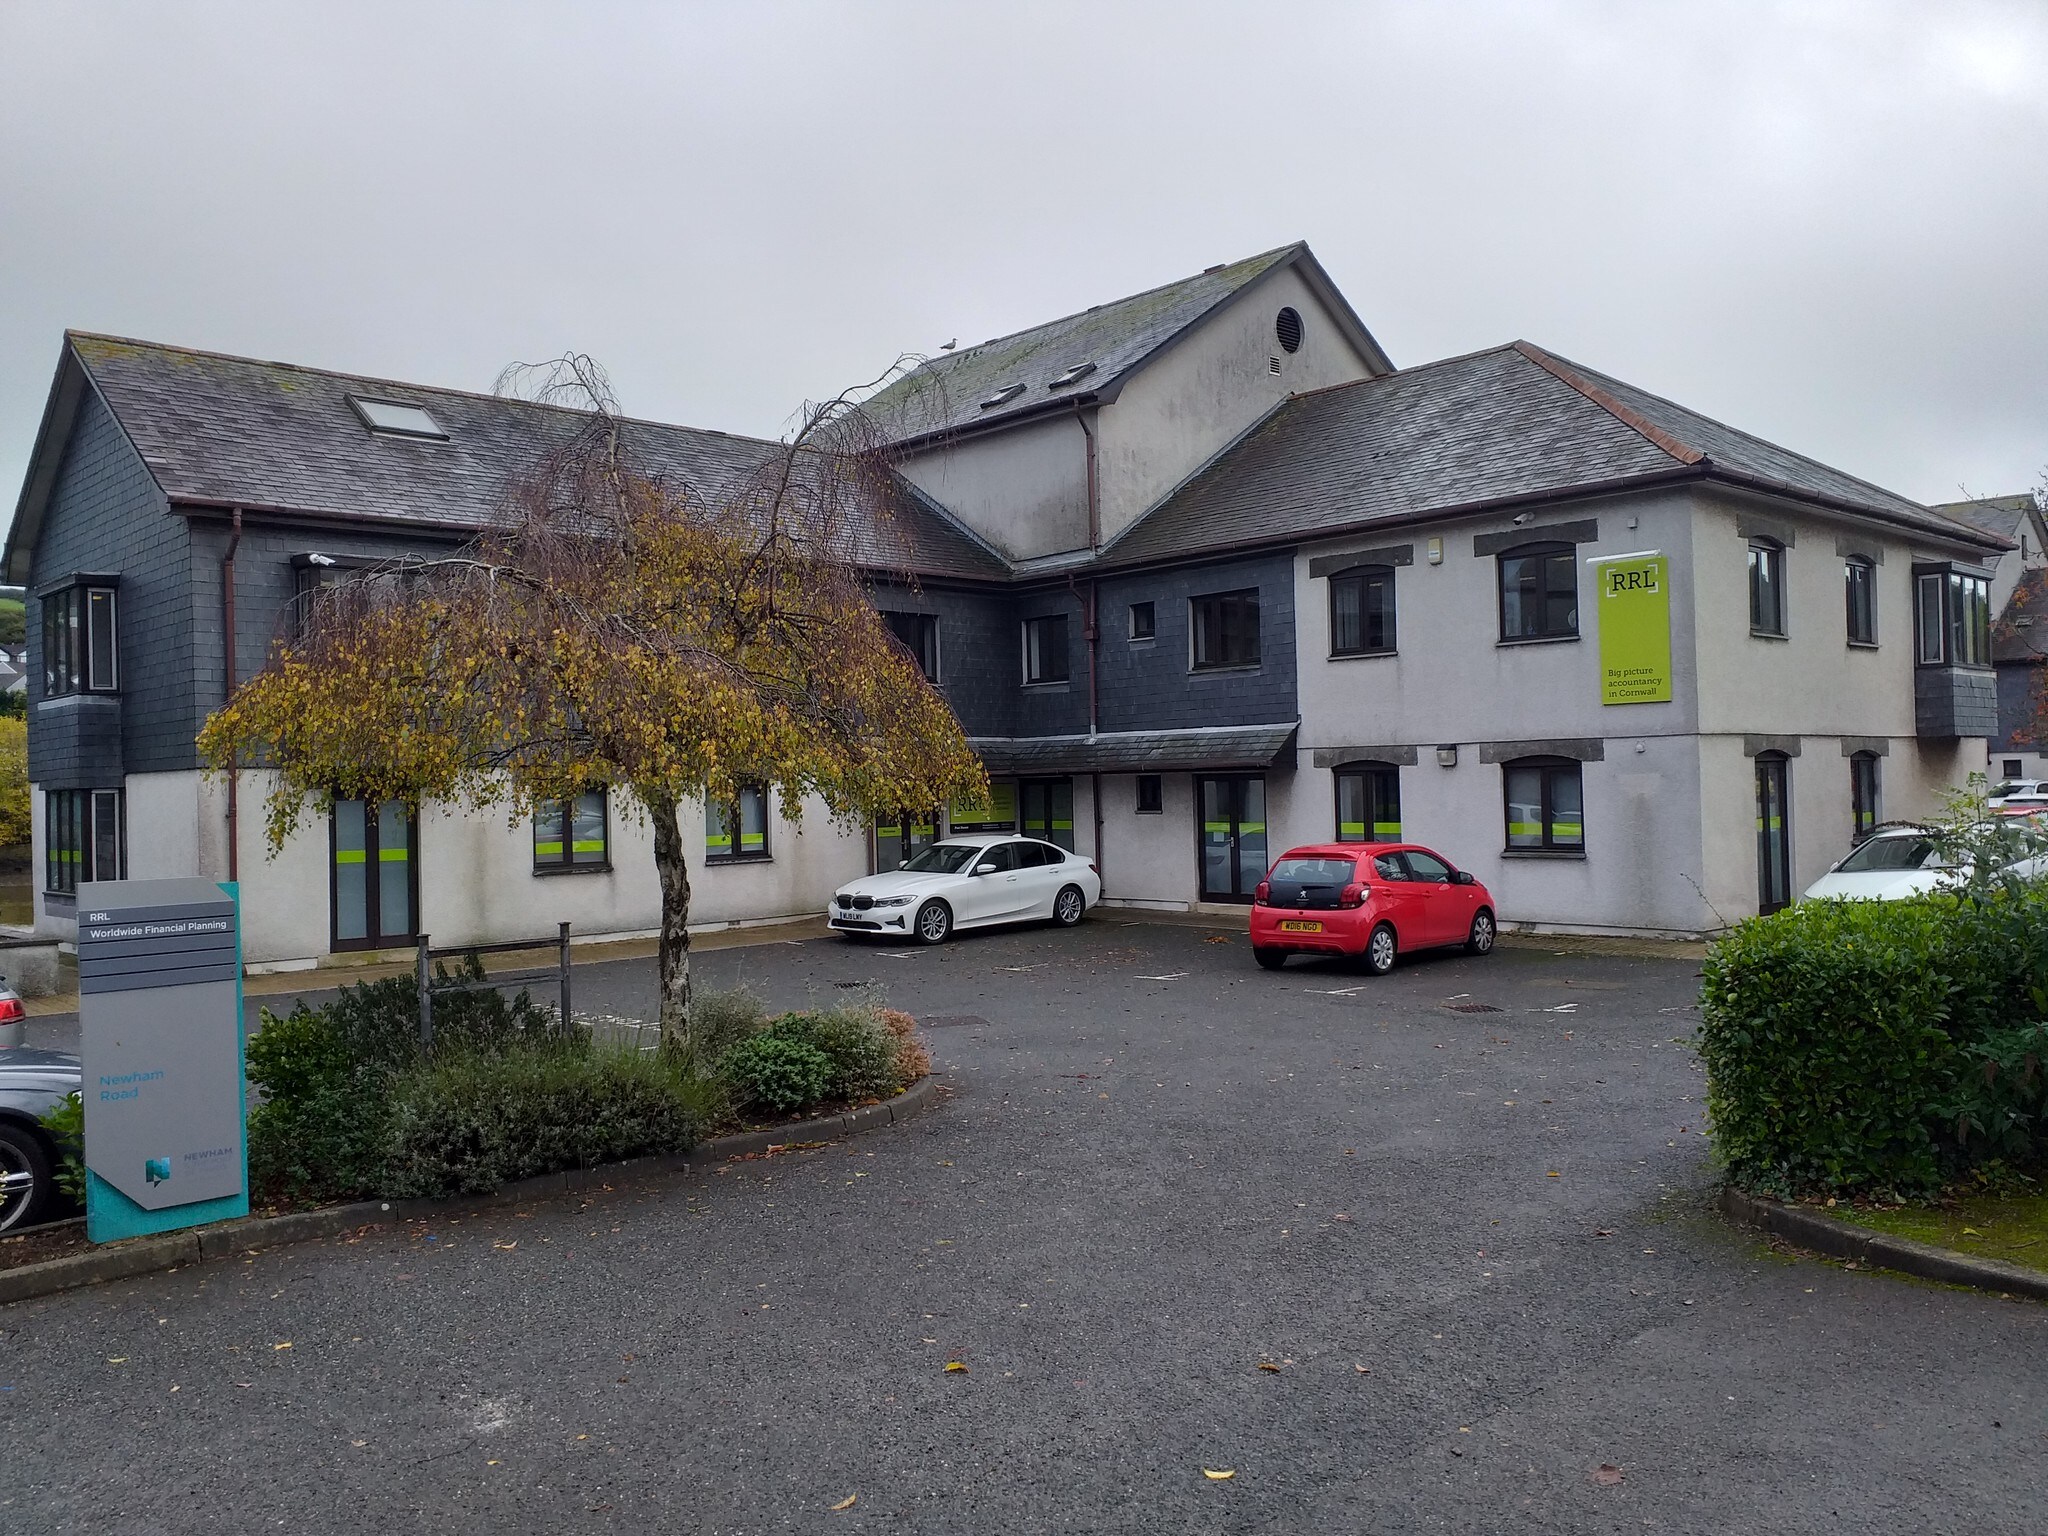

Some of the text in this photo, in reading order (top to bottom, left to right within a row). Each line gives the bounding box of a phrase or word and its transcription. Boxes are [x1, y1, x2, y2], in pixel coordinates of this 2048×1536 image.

[1612, 570, 1656, 591] RRL
[1608, 667, 1654, 679] Big picture
[1608, 677, 1662, 688] accountancy
[1608, 687, 1657, 698] in Cornwall
[90, 913, 111, 921] RRL
[90, 920, 227, 939] Worldwide Financial Planning
[1285, 921, 1318, 931] WD16 NGO
[100, 1070, 164, 1086] Newham
[100, 1086, 138, 1101] Road
[184, 1147, 233, 1161] NEWHAM
